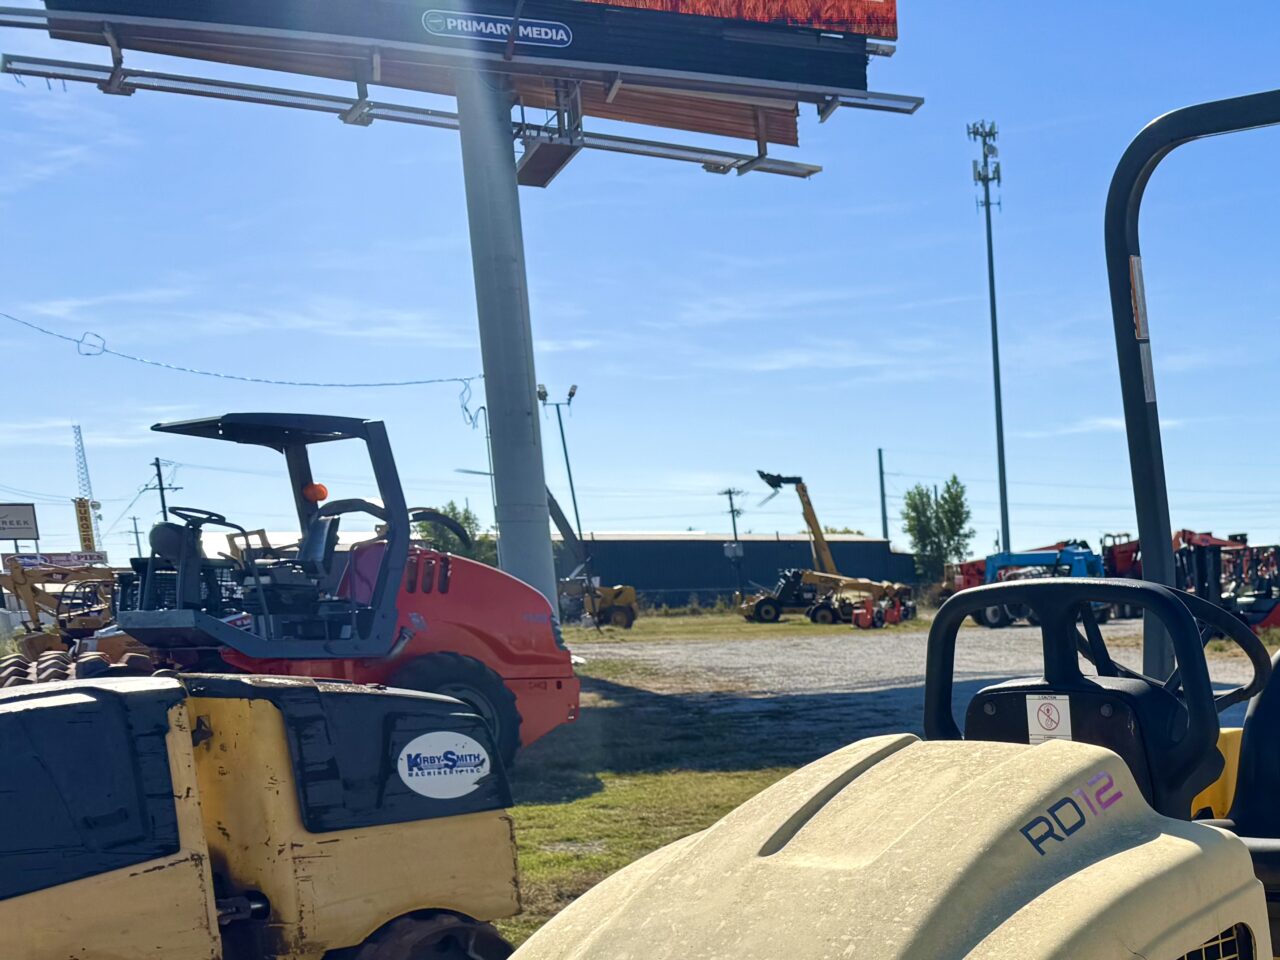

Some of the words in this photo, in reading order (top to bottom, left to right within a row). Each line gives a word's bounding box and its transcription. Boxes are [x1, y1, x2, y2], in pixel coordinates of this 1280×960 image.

[518, 25, 568, 41] MEDIA
[406, 751, 481, 772] KIRBY-SMITH
[1019, 770, 1123, 856] RD12
